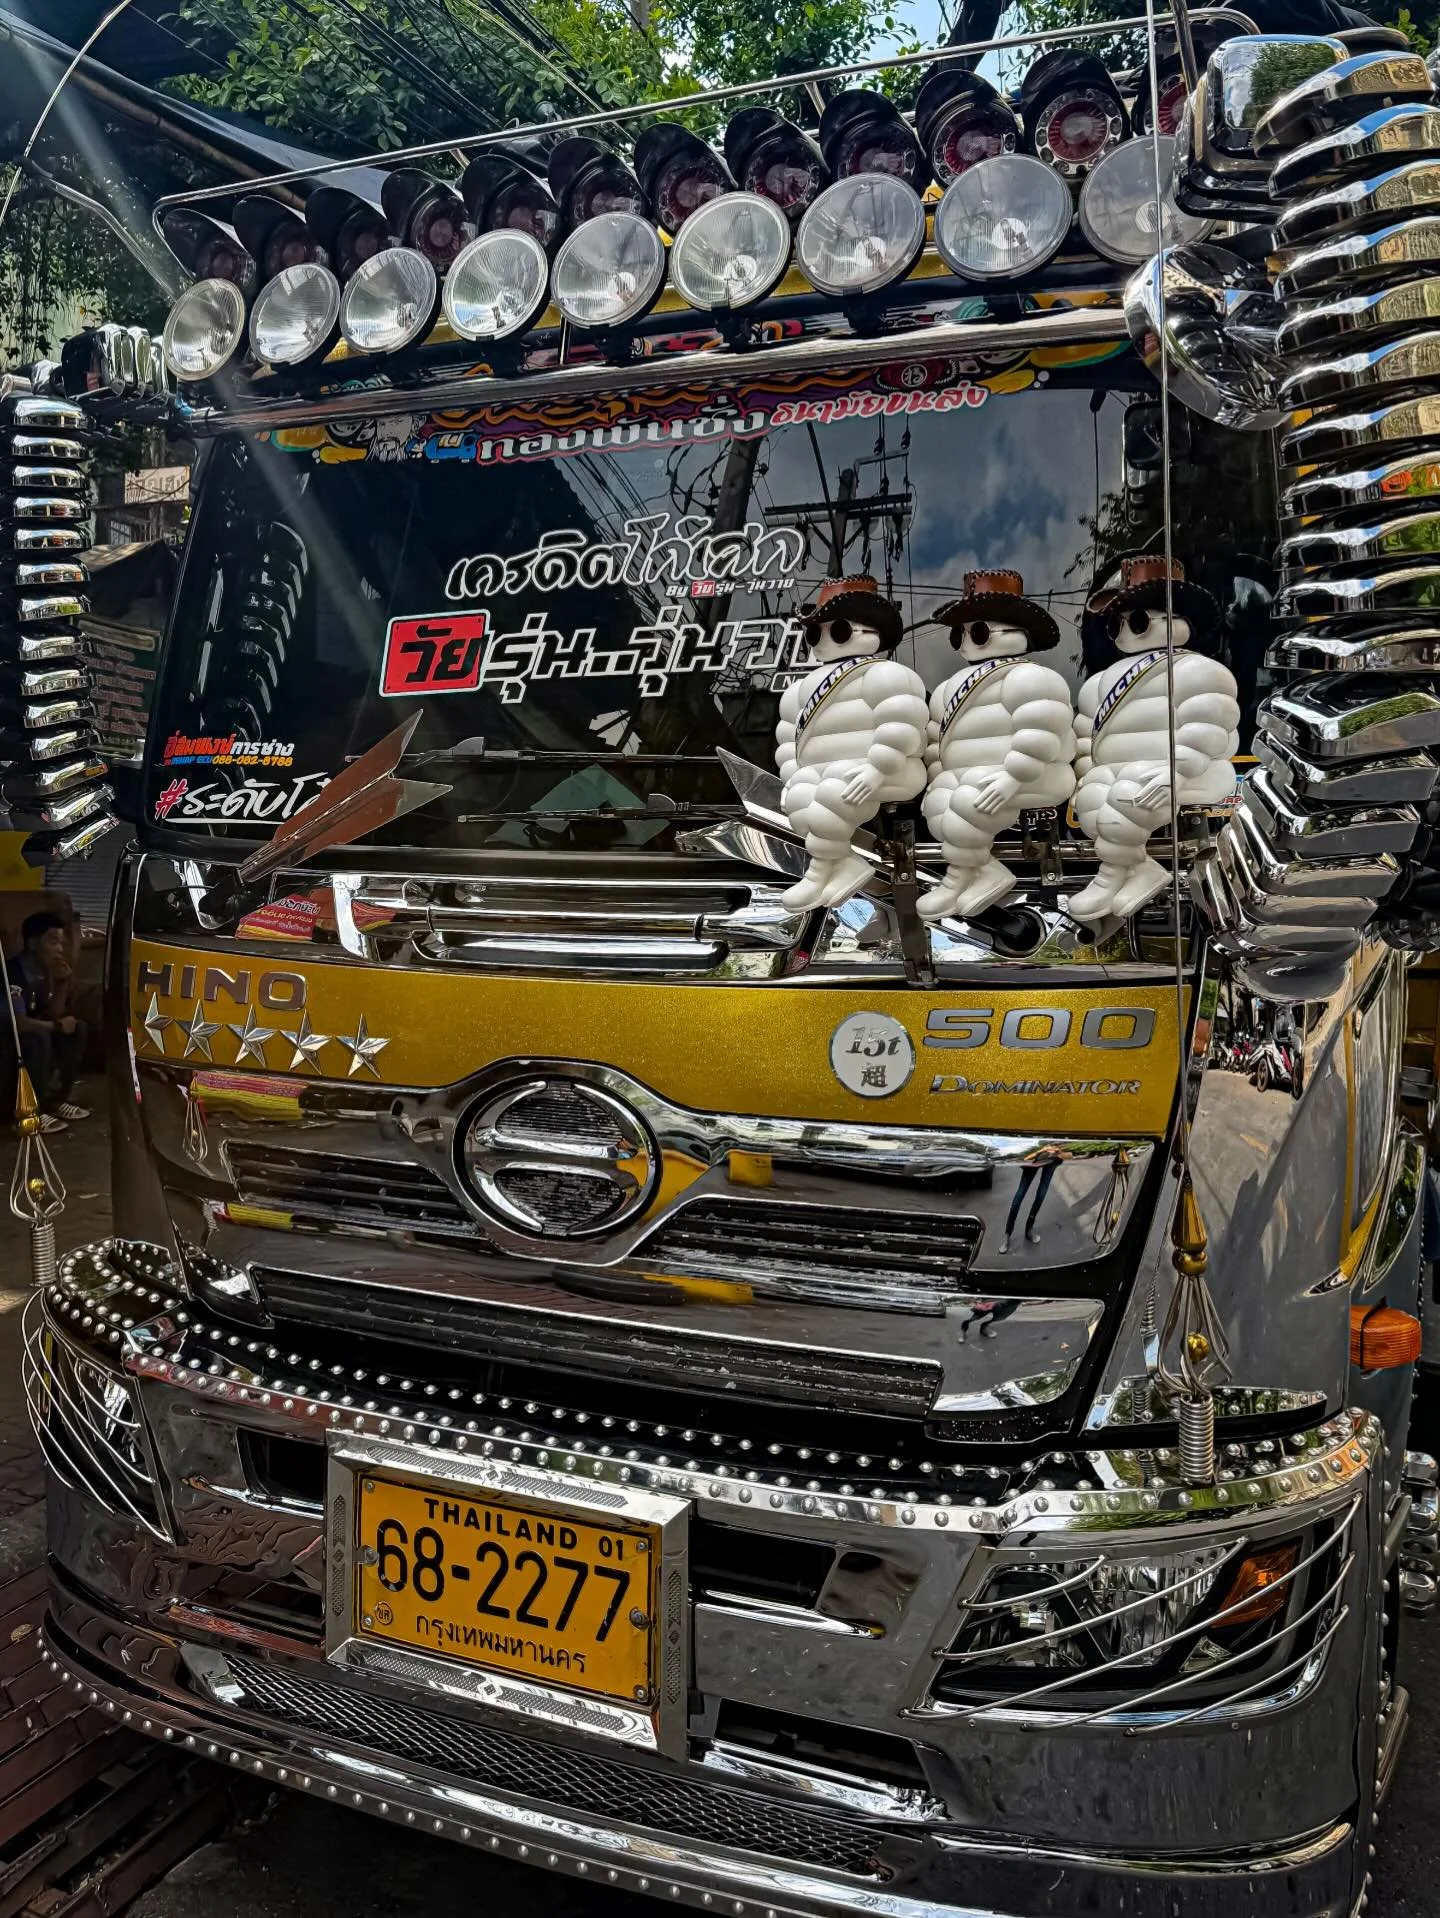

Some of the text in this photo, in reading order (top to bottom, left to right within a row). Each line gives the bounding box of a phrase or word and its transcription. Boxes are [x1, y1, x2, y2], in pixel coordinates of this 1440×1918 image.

[802, 655, 874, 721] MICHEL
[943, 656, 1021, 724] MICHEL
[1098, 649, 1187, 722] MICHEL
[137, 960, 307, 1011] HINO
[845, 1024, 902, 1058] 15t
[922, 1006, 1157, 1050] 500
[929, 1073, 1142, 1097] DOMINATOR
[423, 1497, 625, 1561] THAILAND 01
[376, 1518, 631, 1643] 68-2277
[415, 1614, 586, 1674] กรุงเทพมหานคร
